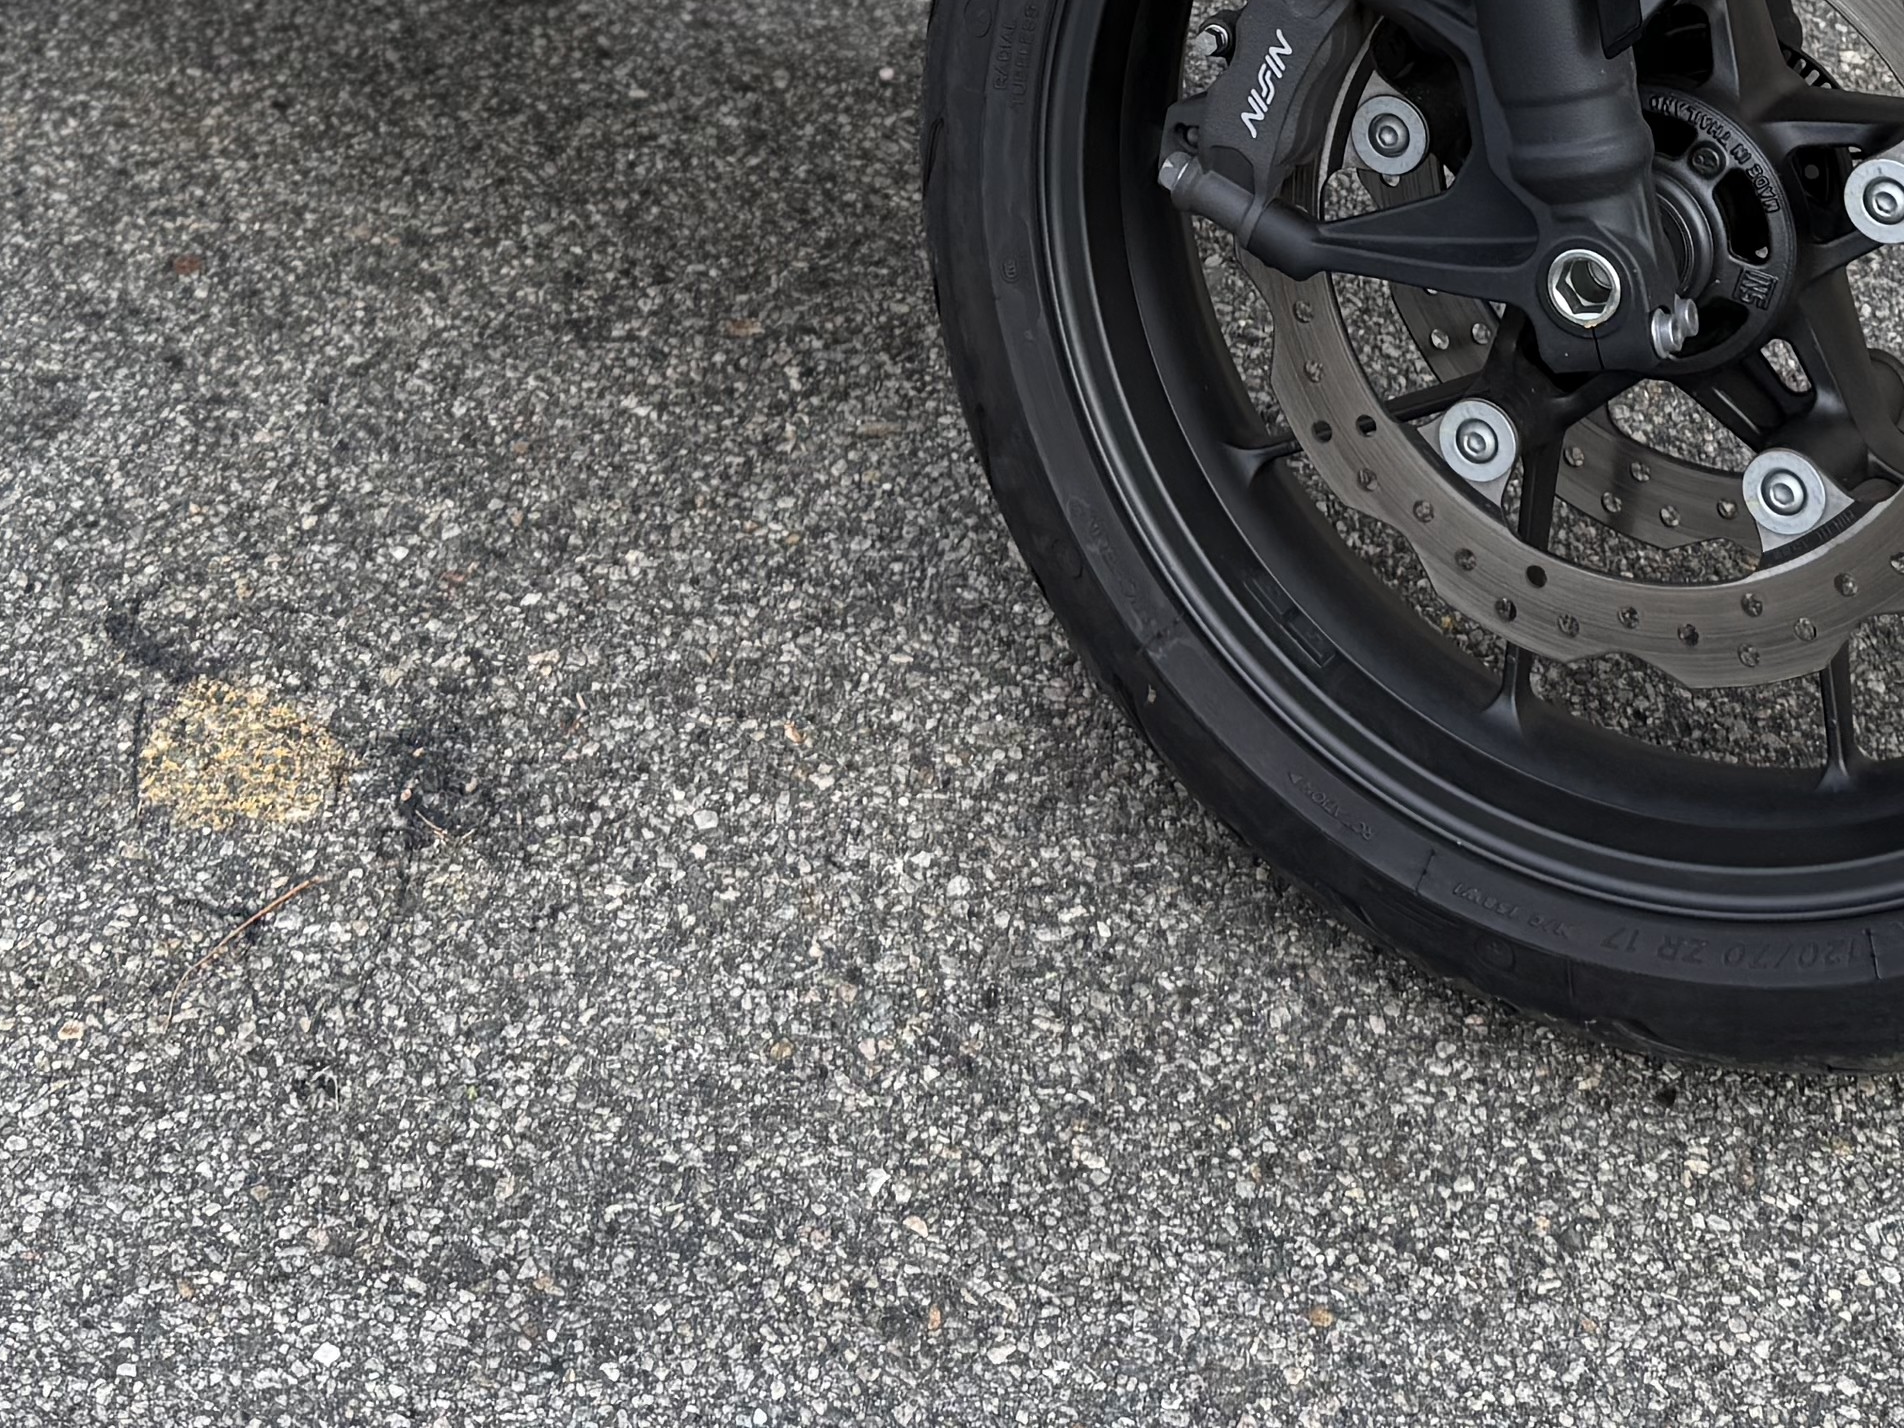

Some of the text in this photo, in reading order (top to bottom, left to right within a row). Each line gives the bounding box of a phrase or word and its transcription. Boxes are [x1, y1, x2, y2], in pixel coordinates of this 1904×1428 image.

[992, 20, 1018, 91] RADIAL
[1649, 95, 1780, 214] MADE IN THAILAND
[1599, 927, 1641, 954] 17
[1657, 934, 1708, 965] ZR
[1723, 935, 1855, 971] 120/70
